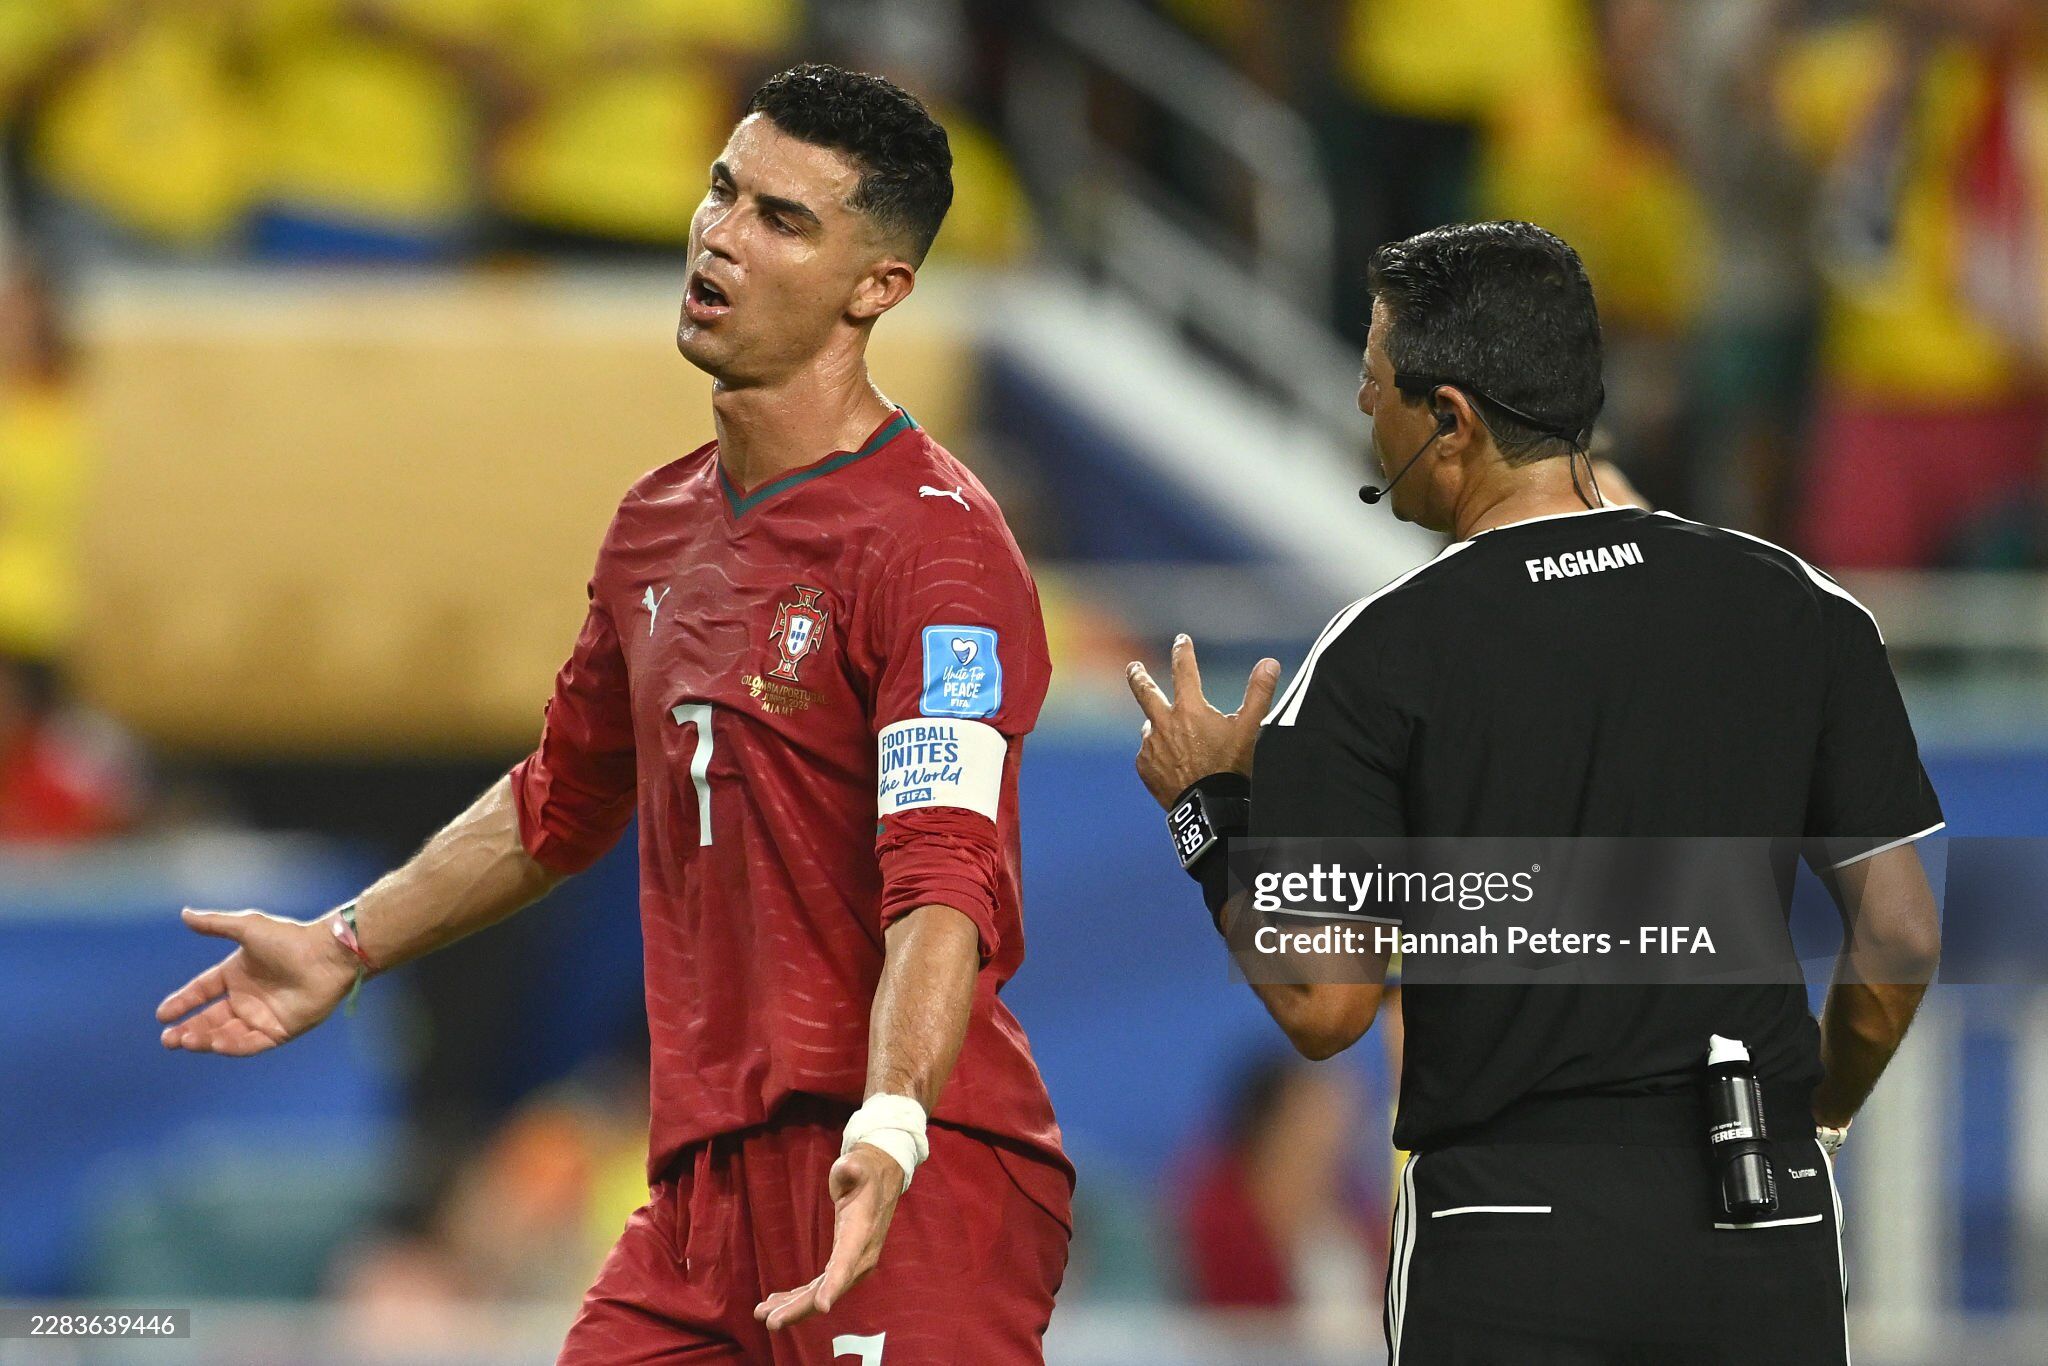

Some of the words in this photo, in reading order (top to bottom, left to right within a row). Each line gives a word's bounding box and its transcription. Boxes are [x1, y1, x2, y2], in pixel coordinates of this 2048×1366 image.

[1525, 542, 1644, 583] FAGHANI
[942, 665, 970, 683] Unite
[969, 666, 986, 682] For
[943, 682, 981, 699] PEACE
[761, 701, 793, 717] MIAMI
[950, 698, 971, 708] FIFA
[882, 726, 958, 752] FOOTBALL
[882, 743, 959, 775] UNITES
[880, 776, 900, 798] the
[903, 764, 963, 787] World
[897, 789, 931, 806] FIFA
